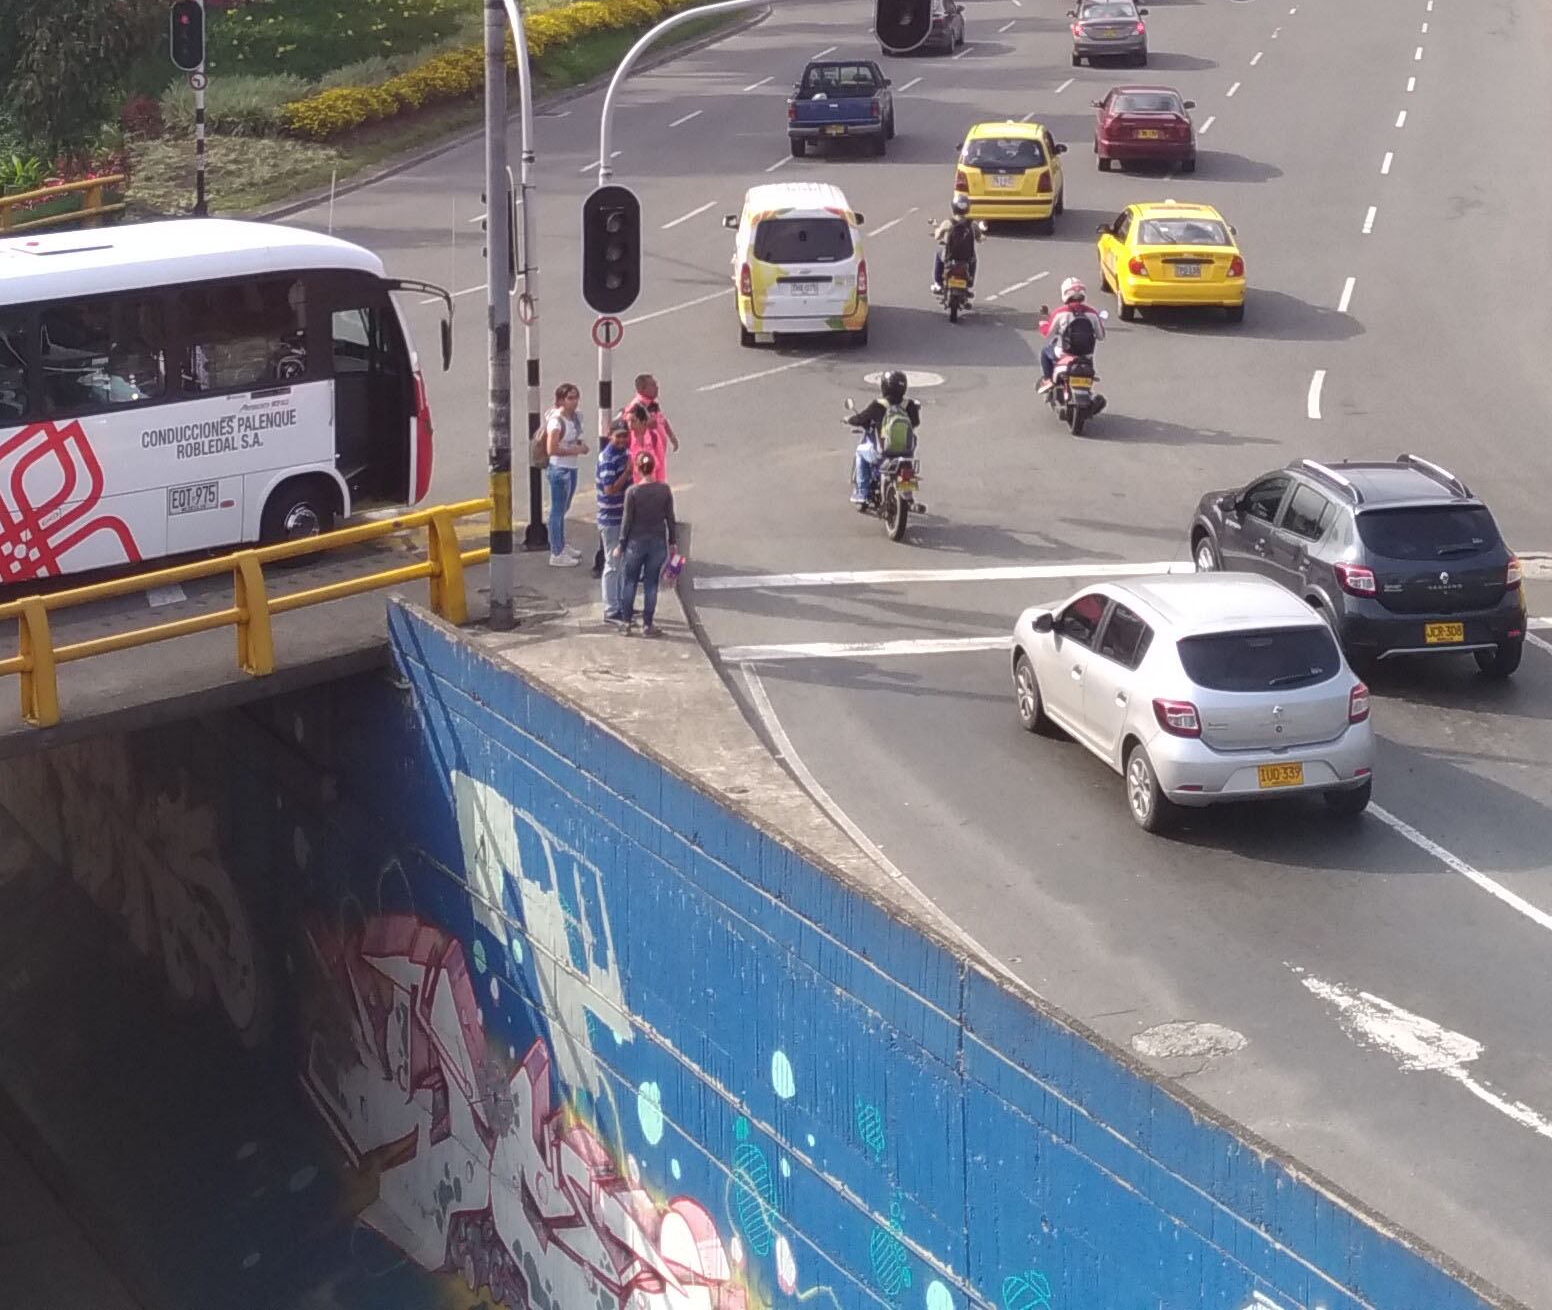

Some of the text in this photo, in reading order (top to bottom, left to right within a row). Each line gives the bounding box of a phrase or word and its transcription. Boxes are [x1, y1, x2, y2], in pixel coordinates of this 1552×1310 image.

[142, 408, 297, 449] CONDUCCIONES PALENQUE
[176, 432, 264, 460] ROBLEDAL S.A.
